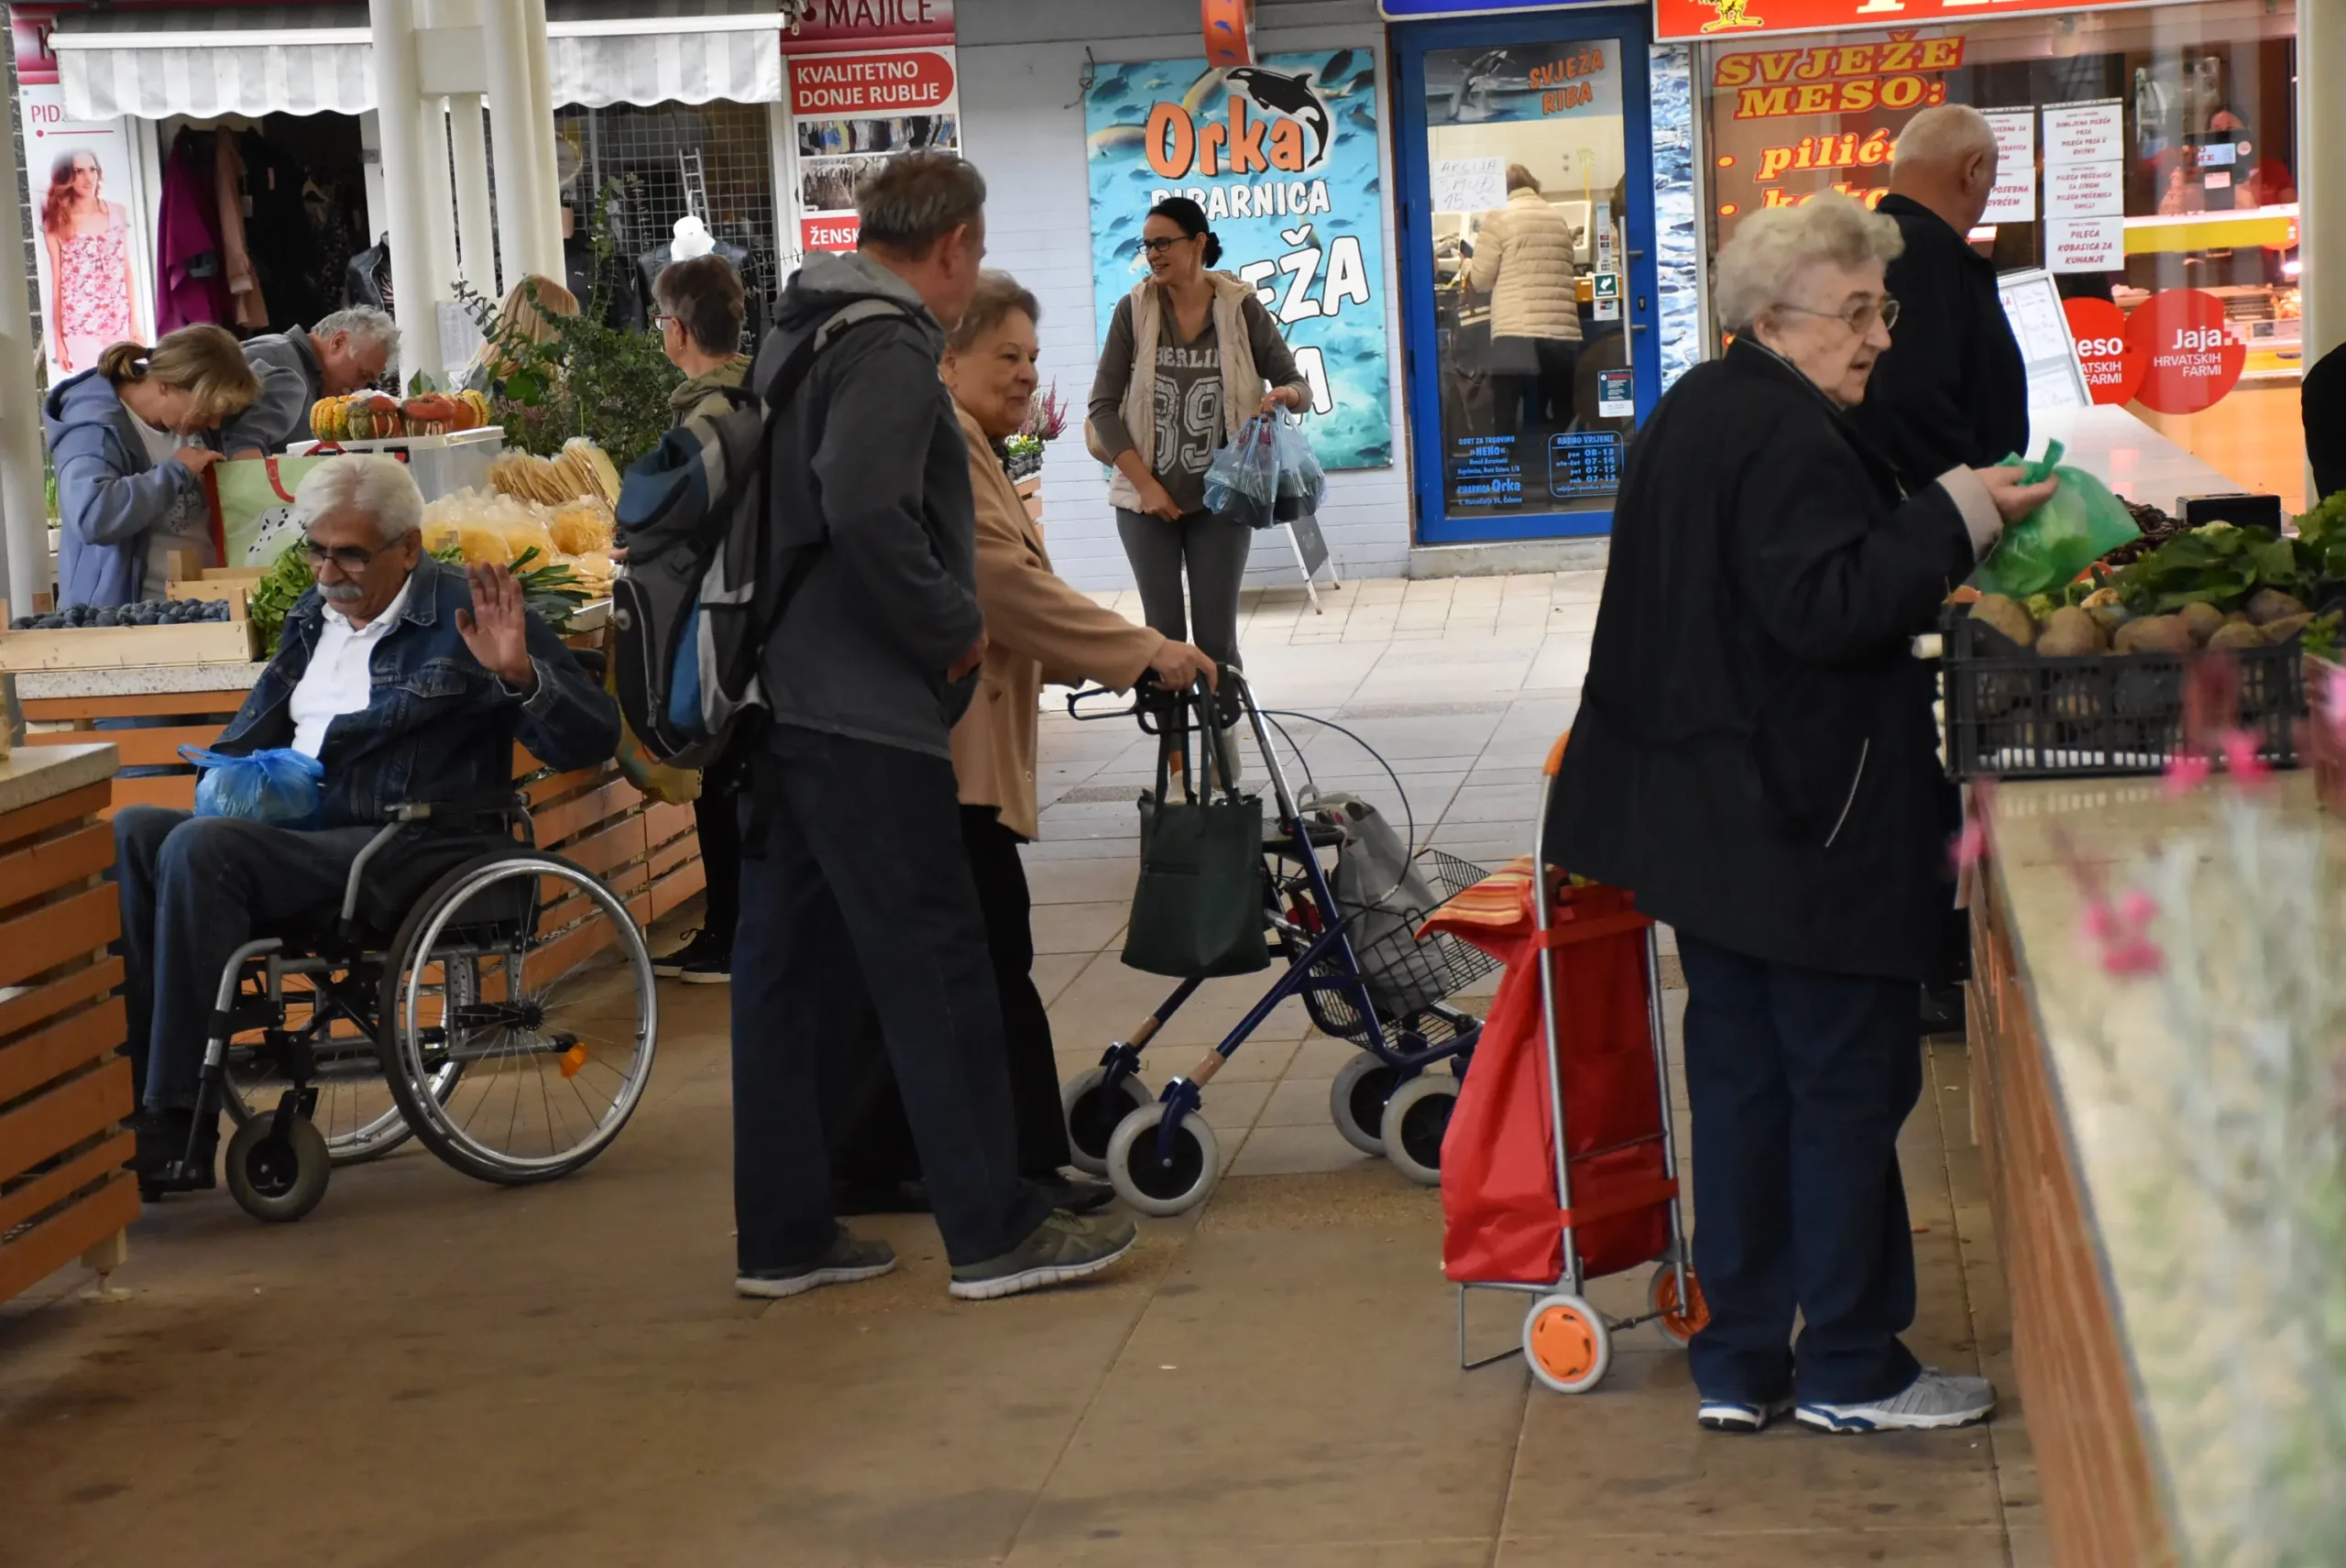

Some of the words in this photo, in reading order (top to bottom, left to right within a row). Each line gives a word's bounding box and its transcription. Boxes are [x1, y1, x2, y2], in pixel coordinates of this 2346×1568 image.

[826, 0, 936, 29] MAJICE
[1529, 47, 1605, 91] SVJEŽA
[1716, 31, 1962, 86] SVJEŽE
[797, 60, 919, 84] KVALITETNO
[799, 88, 864, 107] DONJE
[870, 82, 941, 104] RUBLJE
[1542, 81, 1593, 116] RIBA
[1736, 75, 1943, 118] MESO:
[1146, 94, 1305, 181] Orka
[1992, 185, 2029, 194] POSEBNA
[2057, 243, 2099, 252] KOBASICA
[2101, 242, 2113, 250] ZA
[2065, 255, 2105, 265] KUHANJE
[2073, 336, 2124, 356] eso
[2172, 325, 2222, 353] Jaja
[2154, 353, 2221, 367] HRVATSKIH
[2183, 365, 2221, 378] FARMI
[1557, 436, 1582, 445] RADNO
[1584, 434, 1615, 443] VRIJEME
[1492, 477, 1521, 493] Orka
